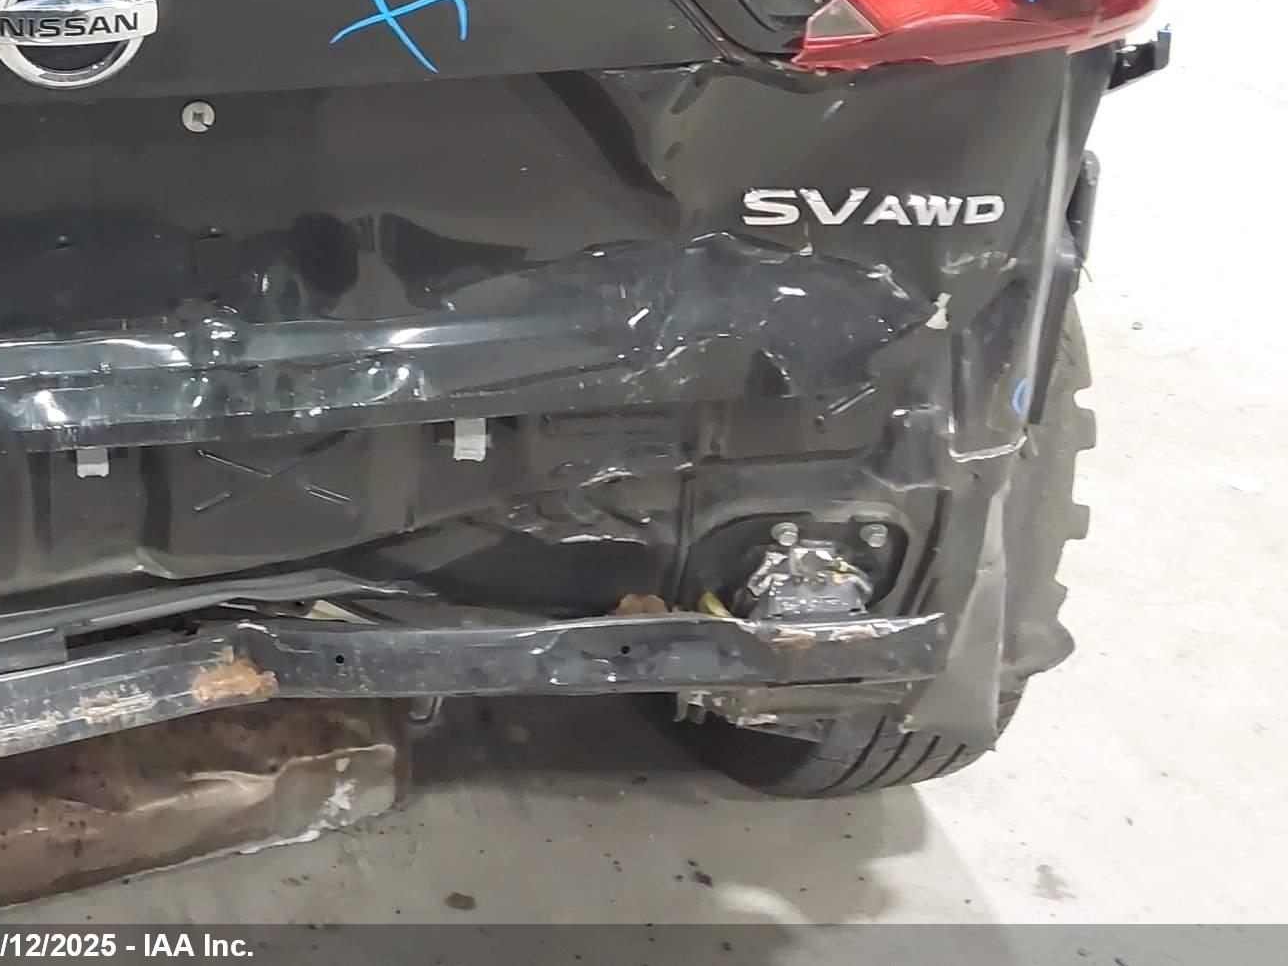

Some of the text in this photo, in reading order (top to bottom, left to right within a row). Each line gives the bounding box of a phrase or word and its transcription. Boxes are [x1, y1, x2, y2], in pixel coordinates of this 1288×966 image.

[0, 12, 138, 37] NISSAN
[742, 187, 1006, 227] SV AWD
